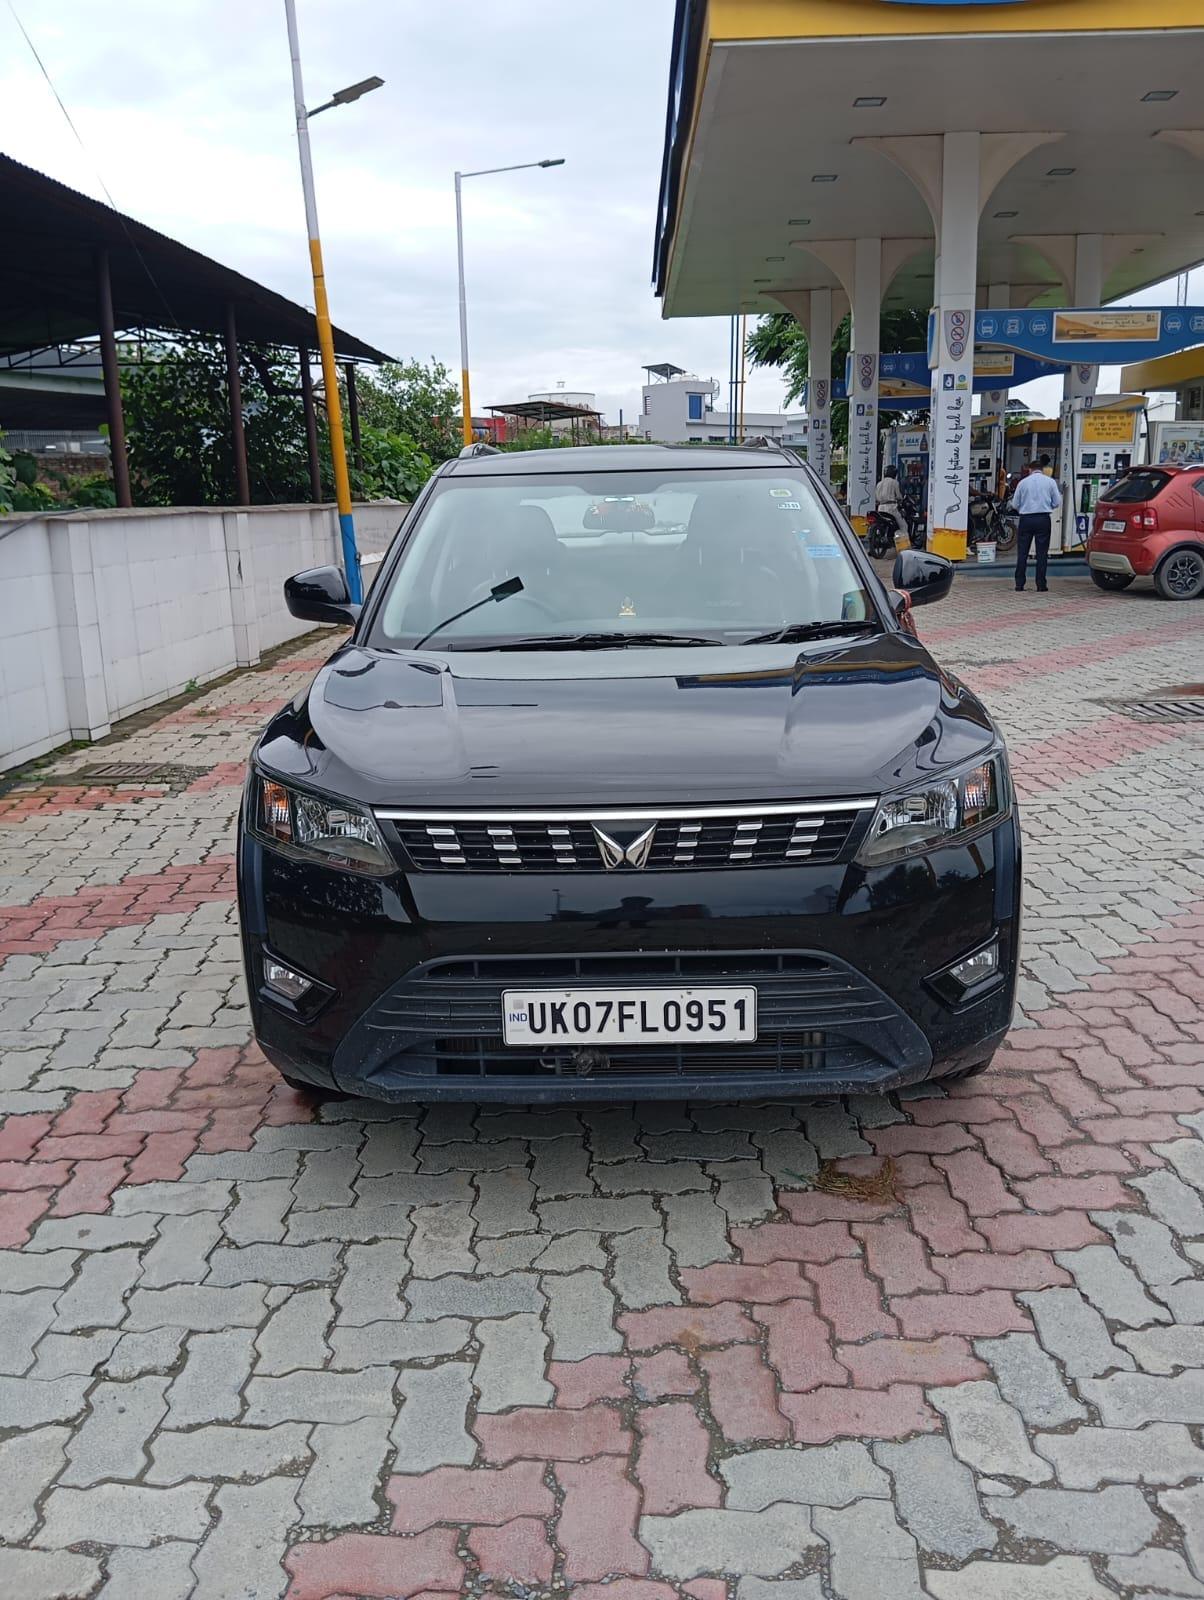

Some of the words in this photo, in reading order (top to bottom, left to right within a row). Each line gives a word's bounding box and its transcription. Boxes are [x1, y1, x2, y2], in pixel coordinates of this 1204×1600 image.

[945, 413, 966, 431] feel
[946, 446, 964, 471] future
[943, 473, 962, 486] Ab
[508, 1012, 528, 1023] IND
[527, 998, 746, 1034] UK07FL0951
